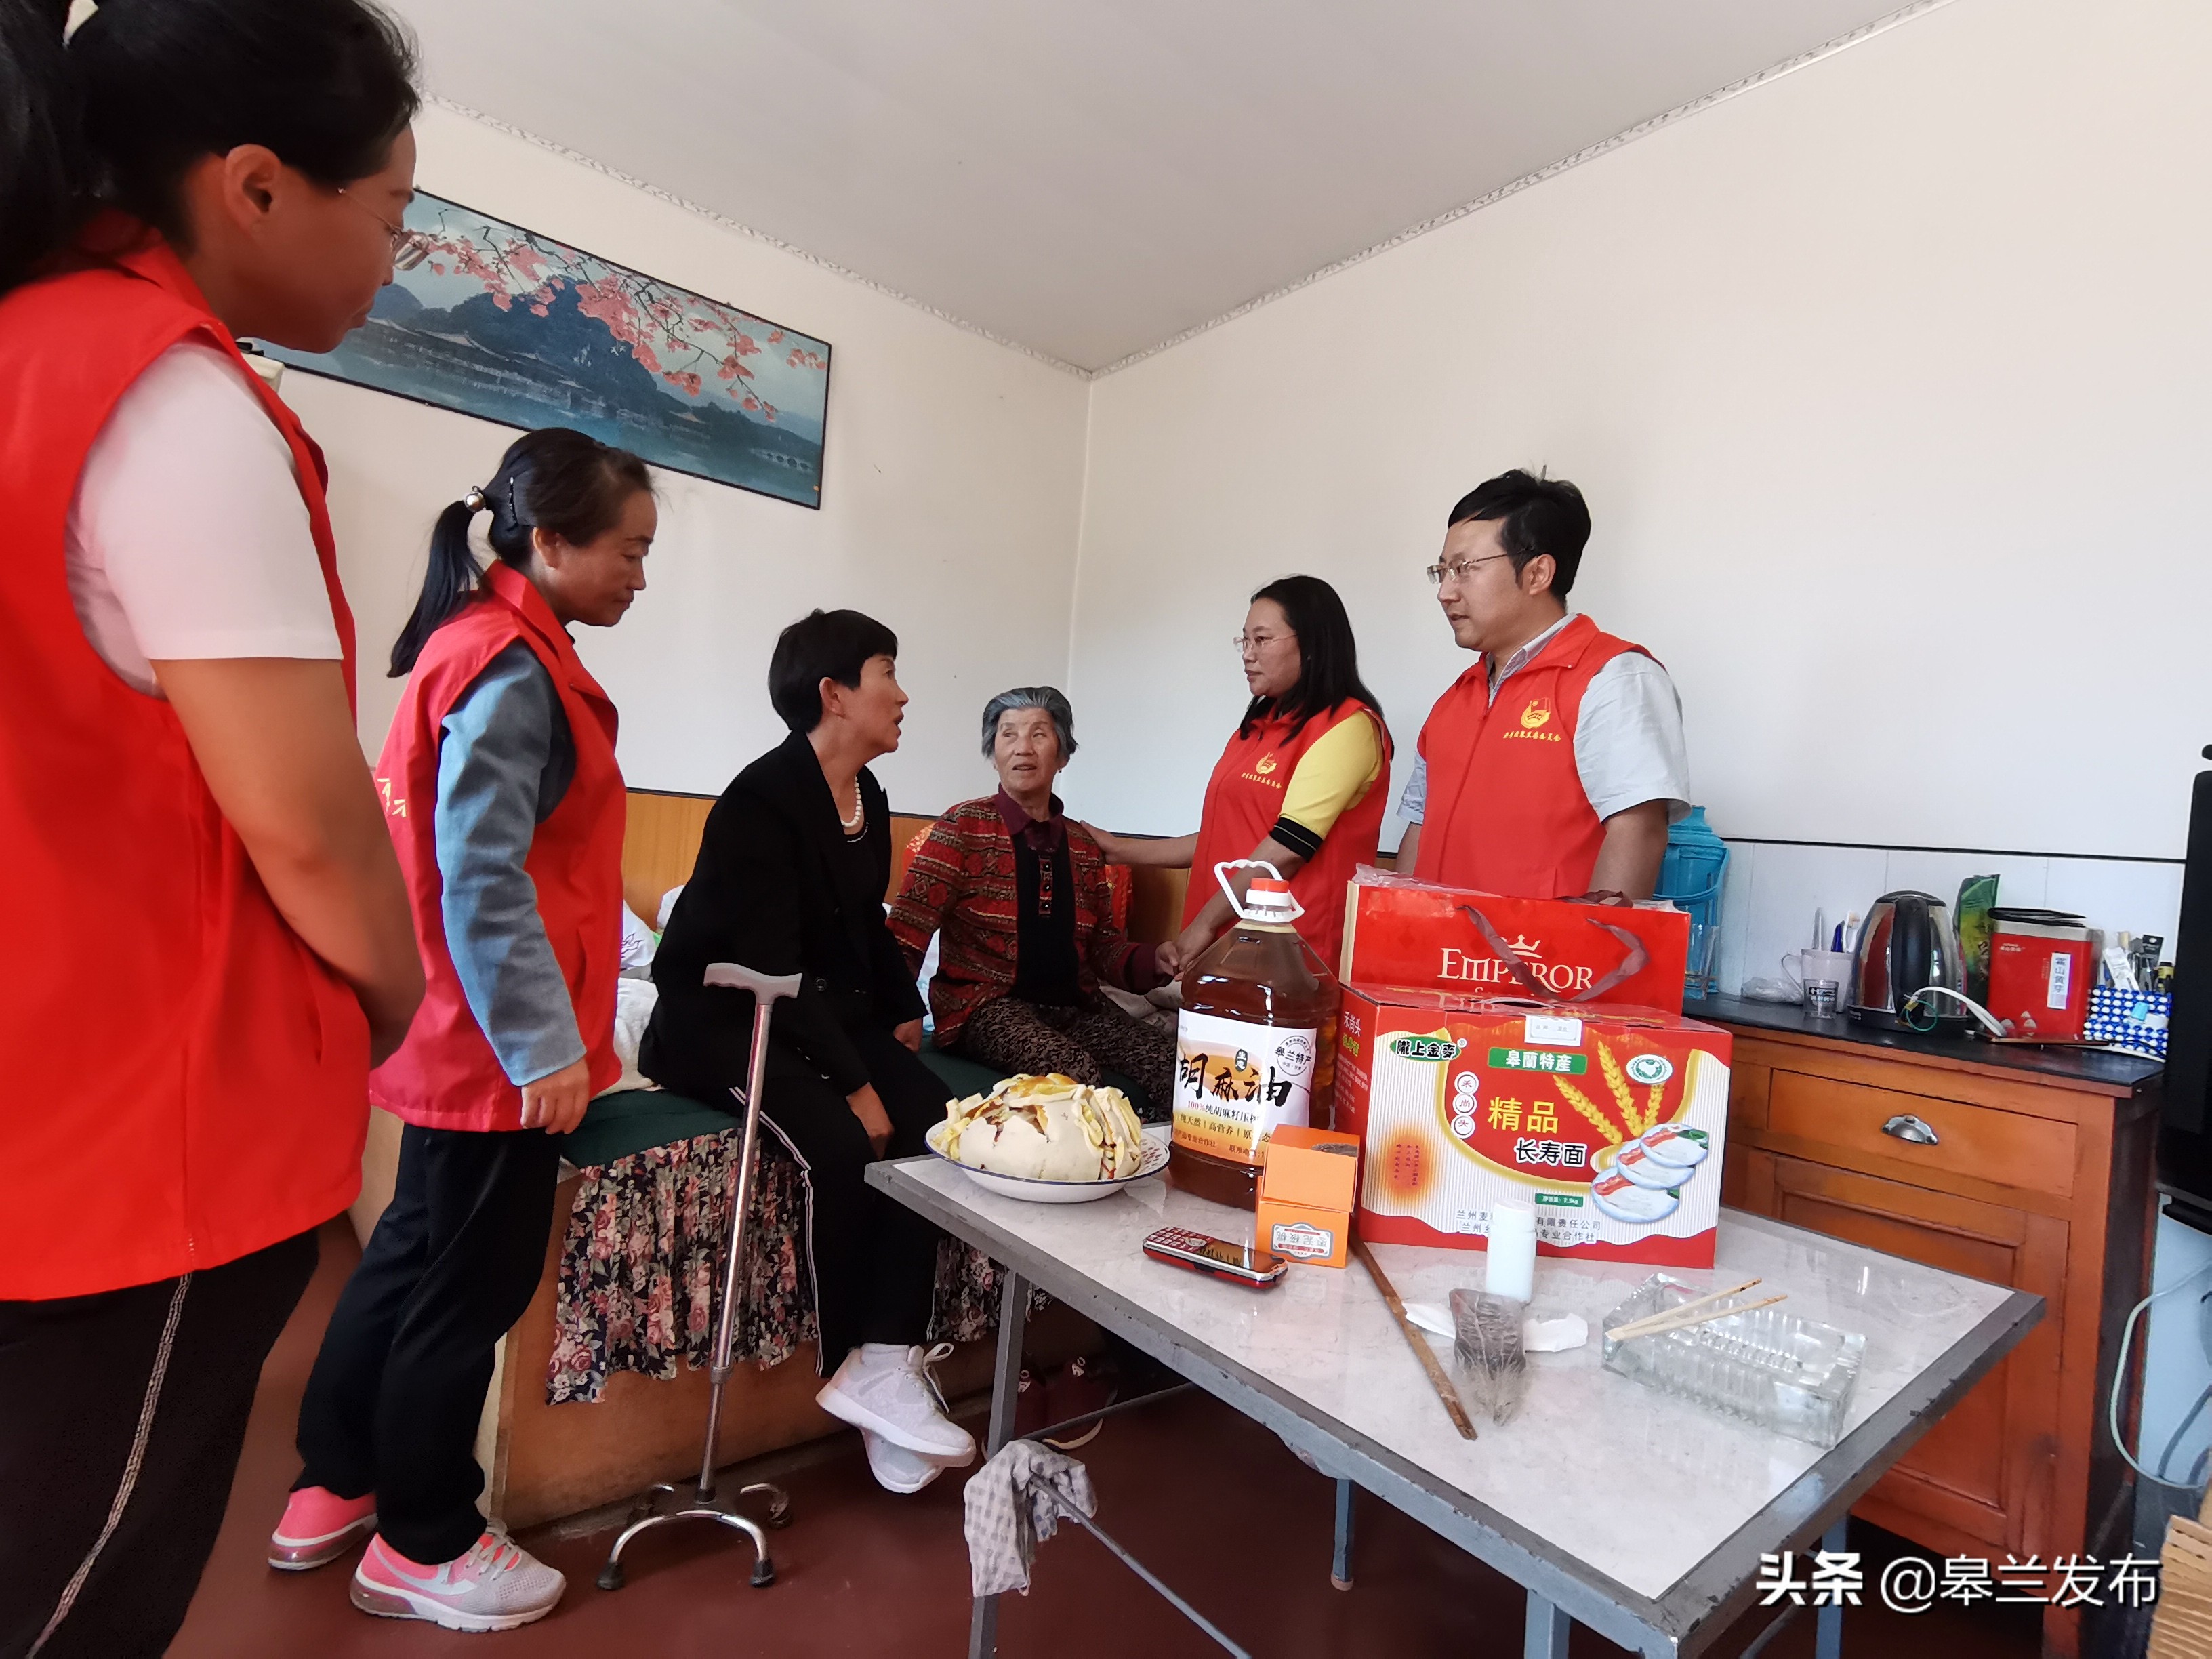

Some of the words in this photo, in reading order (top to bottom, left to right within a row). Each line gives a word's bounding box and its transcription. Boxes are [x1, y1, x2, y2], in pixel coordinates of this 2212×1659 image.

[1437, 947, 1593, 993] EMPROR
[1179, 1052, 1292, 1107] 胡麻油
[1487, 1096, 1559, 1134] 精品
[1515, 1139, 1586, 1166] 长寿面
